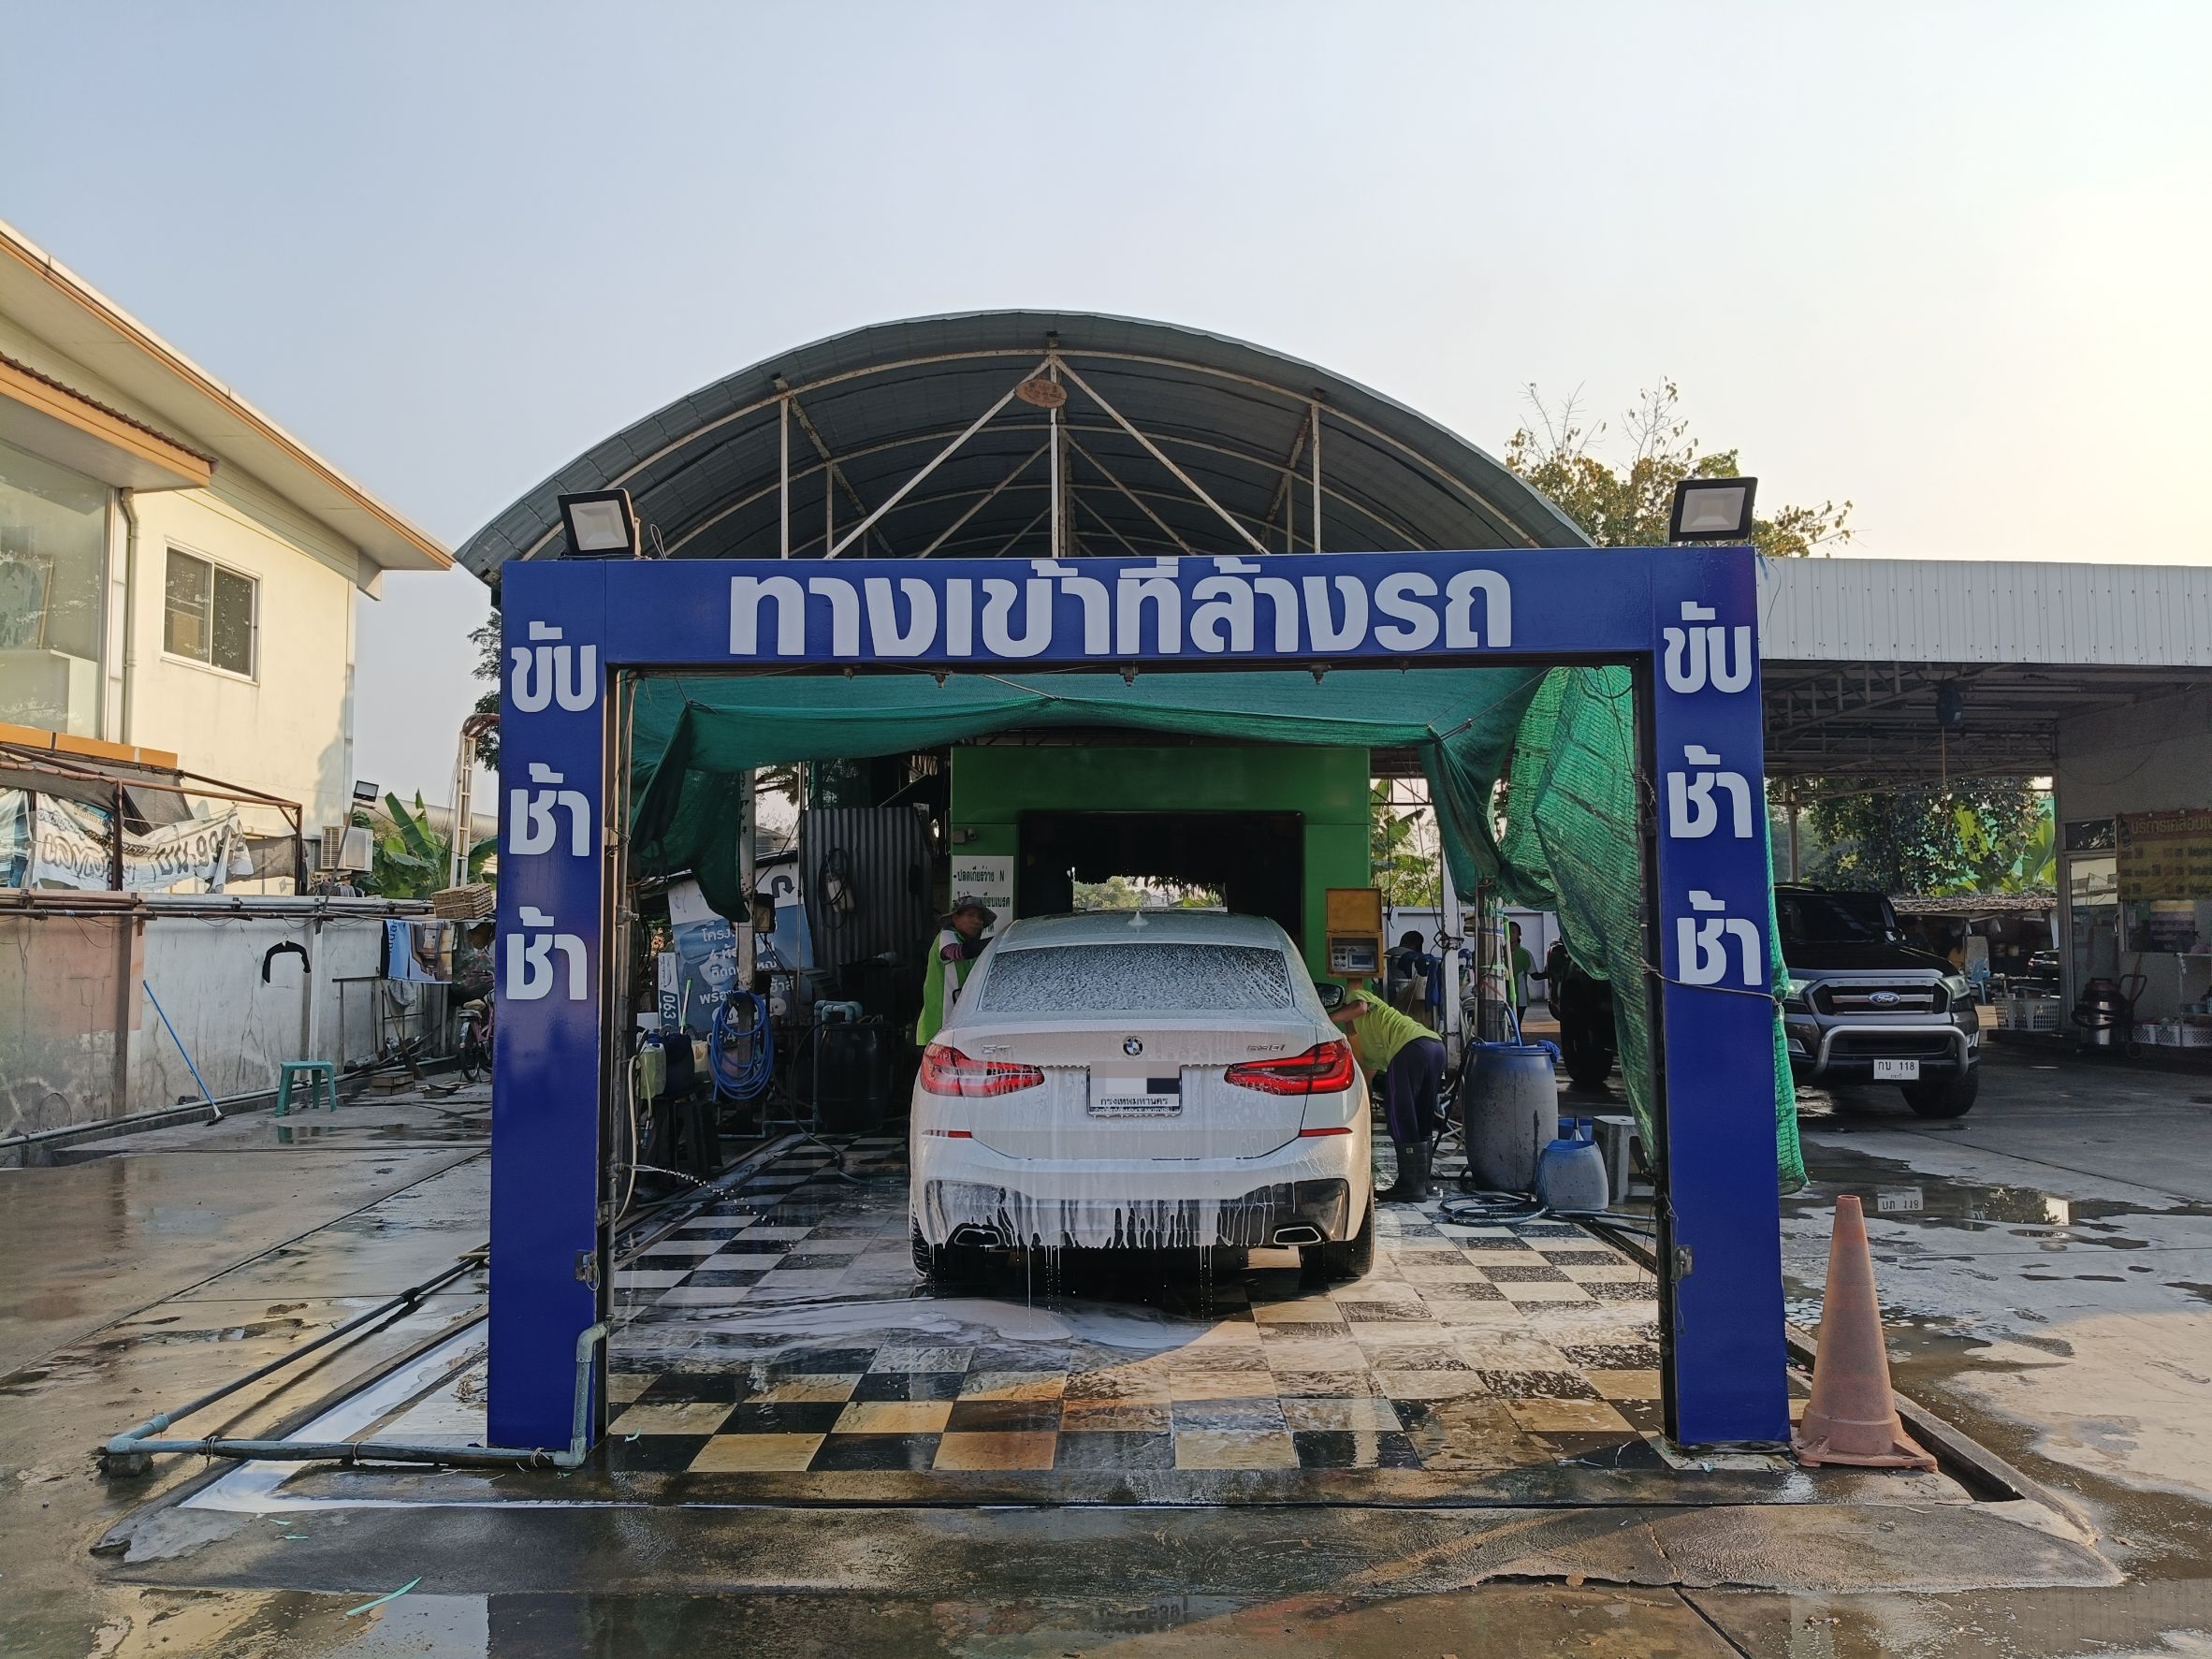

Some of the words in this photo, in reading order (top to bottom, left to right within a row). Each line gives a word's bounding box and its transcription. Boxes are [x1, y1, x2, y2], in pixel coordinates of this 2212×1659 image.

[730, 556, 1512, 657] ทางเข้าที่ล้างรถ
[1663, 602, 1752, 693] ขับ
[511, 621, 597, 713] ขับ
[509, 763, 590, 856] ช้า
[1667, 745, 1753, 838] ช้า
[999, 870, 1005, 882] N
[506, 906, 588, 1000] ช้า
[1677, 890, 1762, 986] ช้า
[1876, 994, 1894, 1003] Ford
[1878, 1061, 1891, 1070] กบ
[1899, 1061, 1914, 1070] 118
